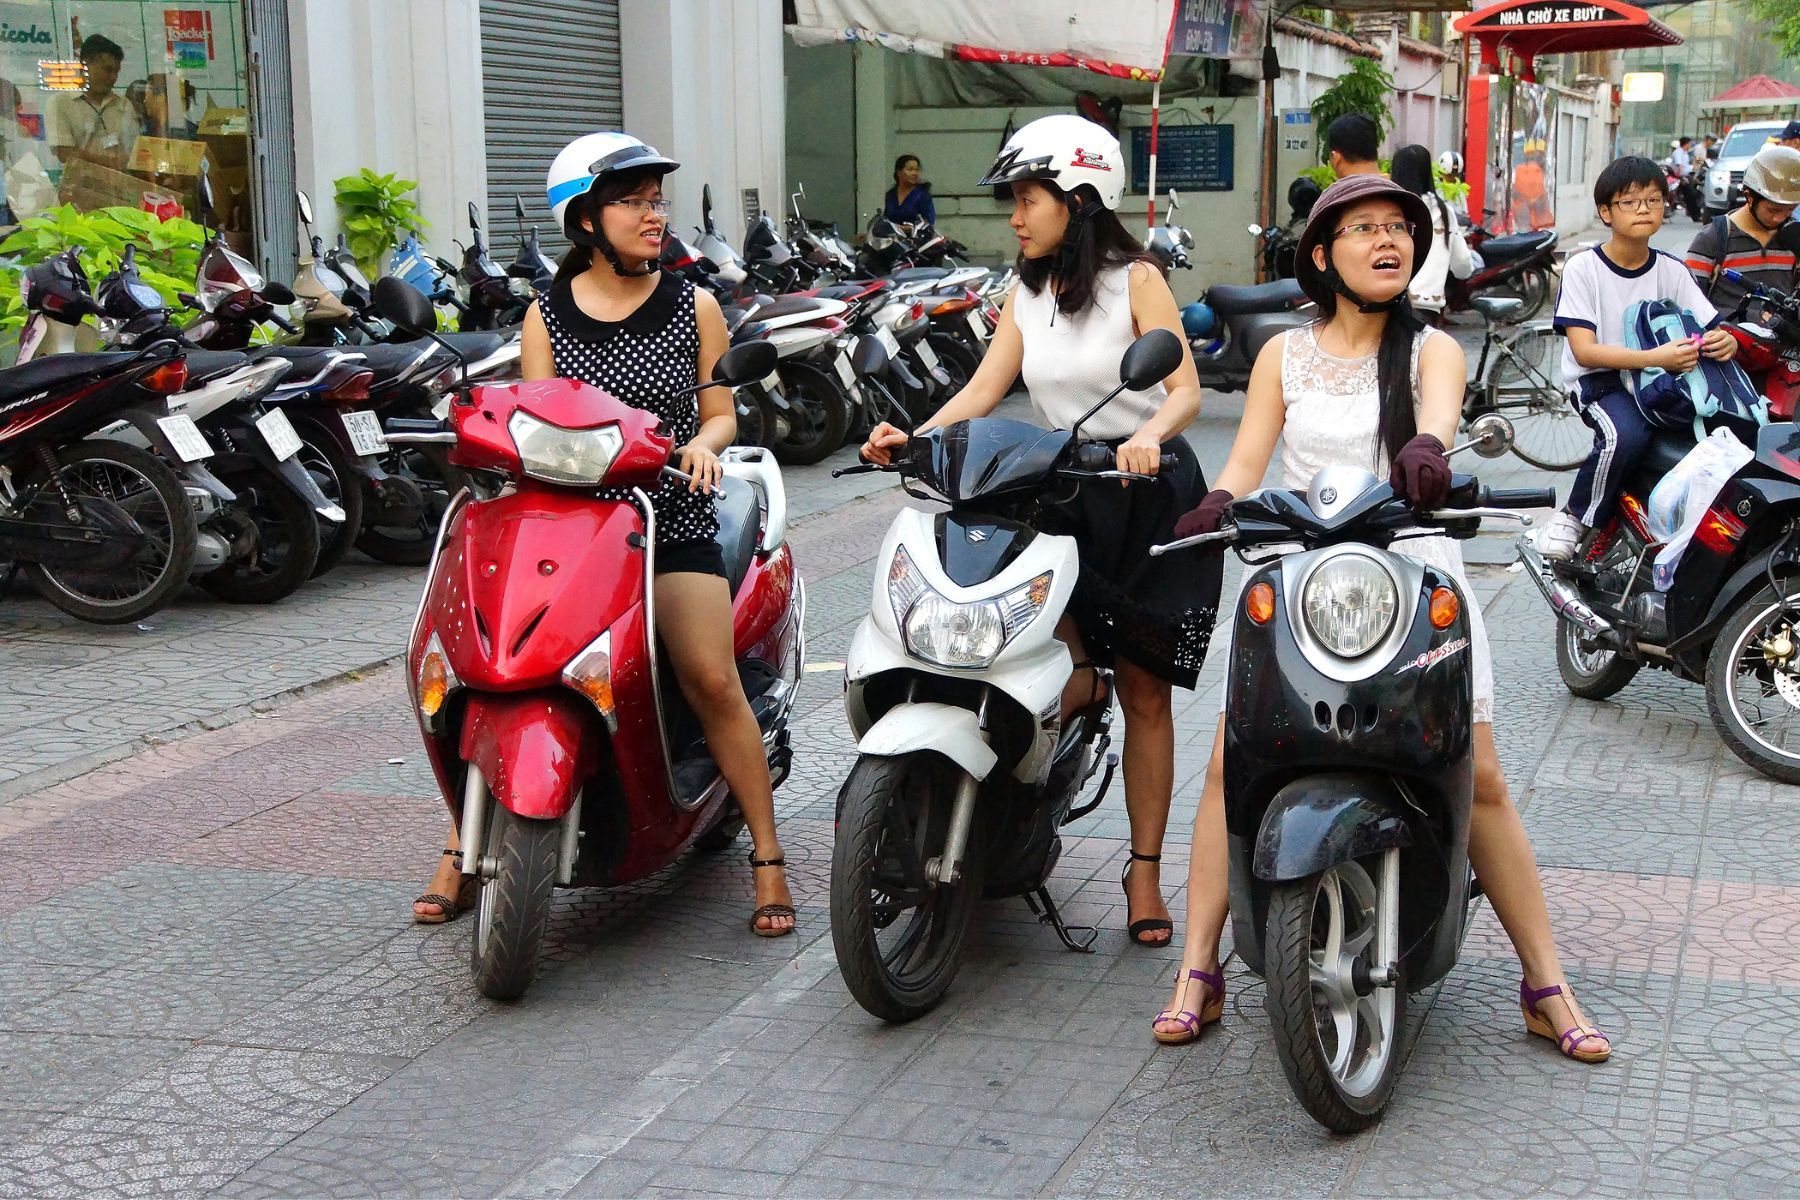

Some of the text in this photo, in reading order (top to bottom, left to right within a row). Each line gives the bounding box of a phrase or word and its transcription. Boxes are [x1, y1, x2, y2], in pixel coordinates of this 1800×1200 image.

[1500, 5, 1605, 25] NHÀ CHỜ XE BUÝT
